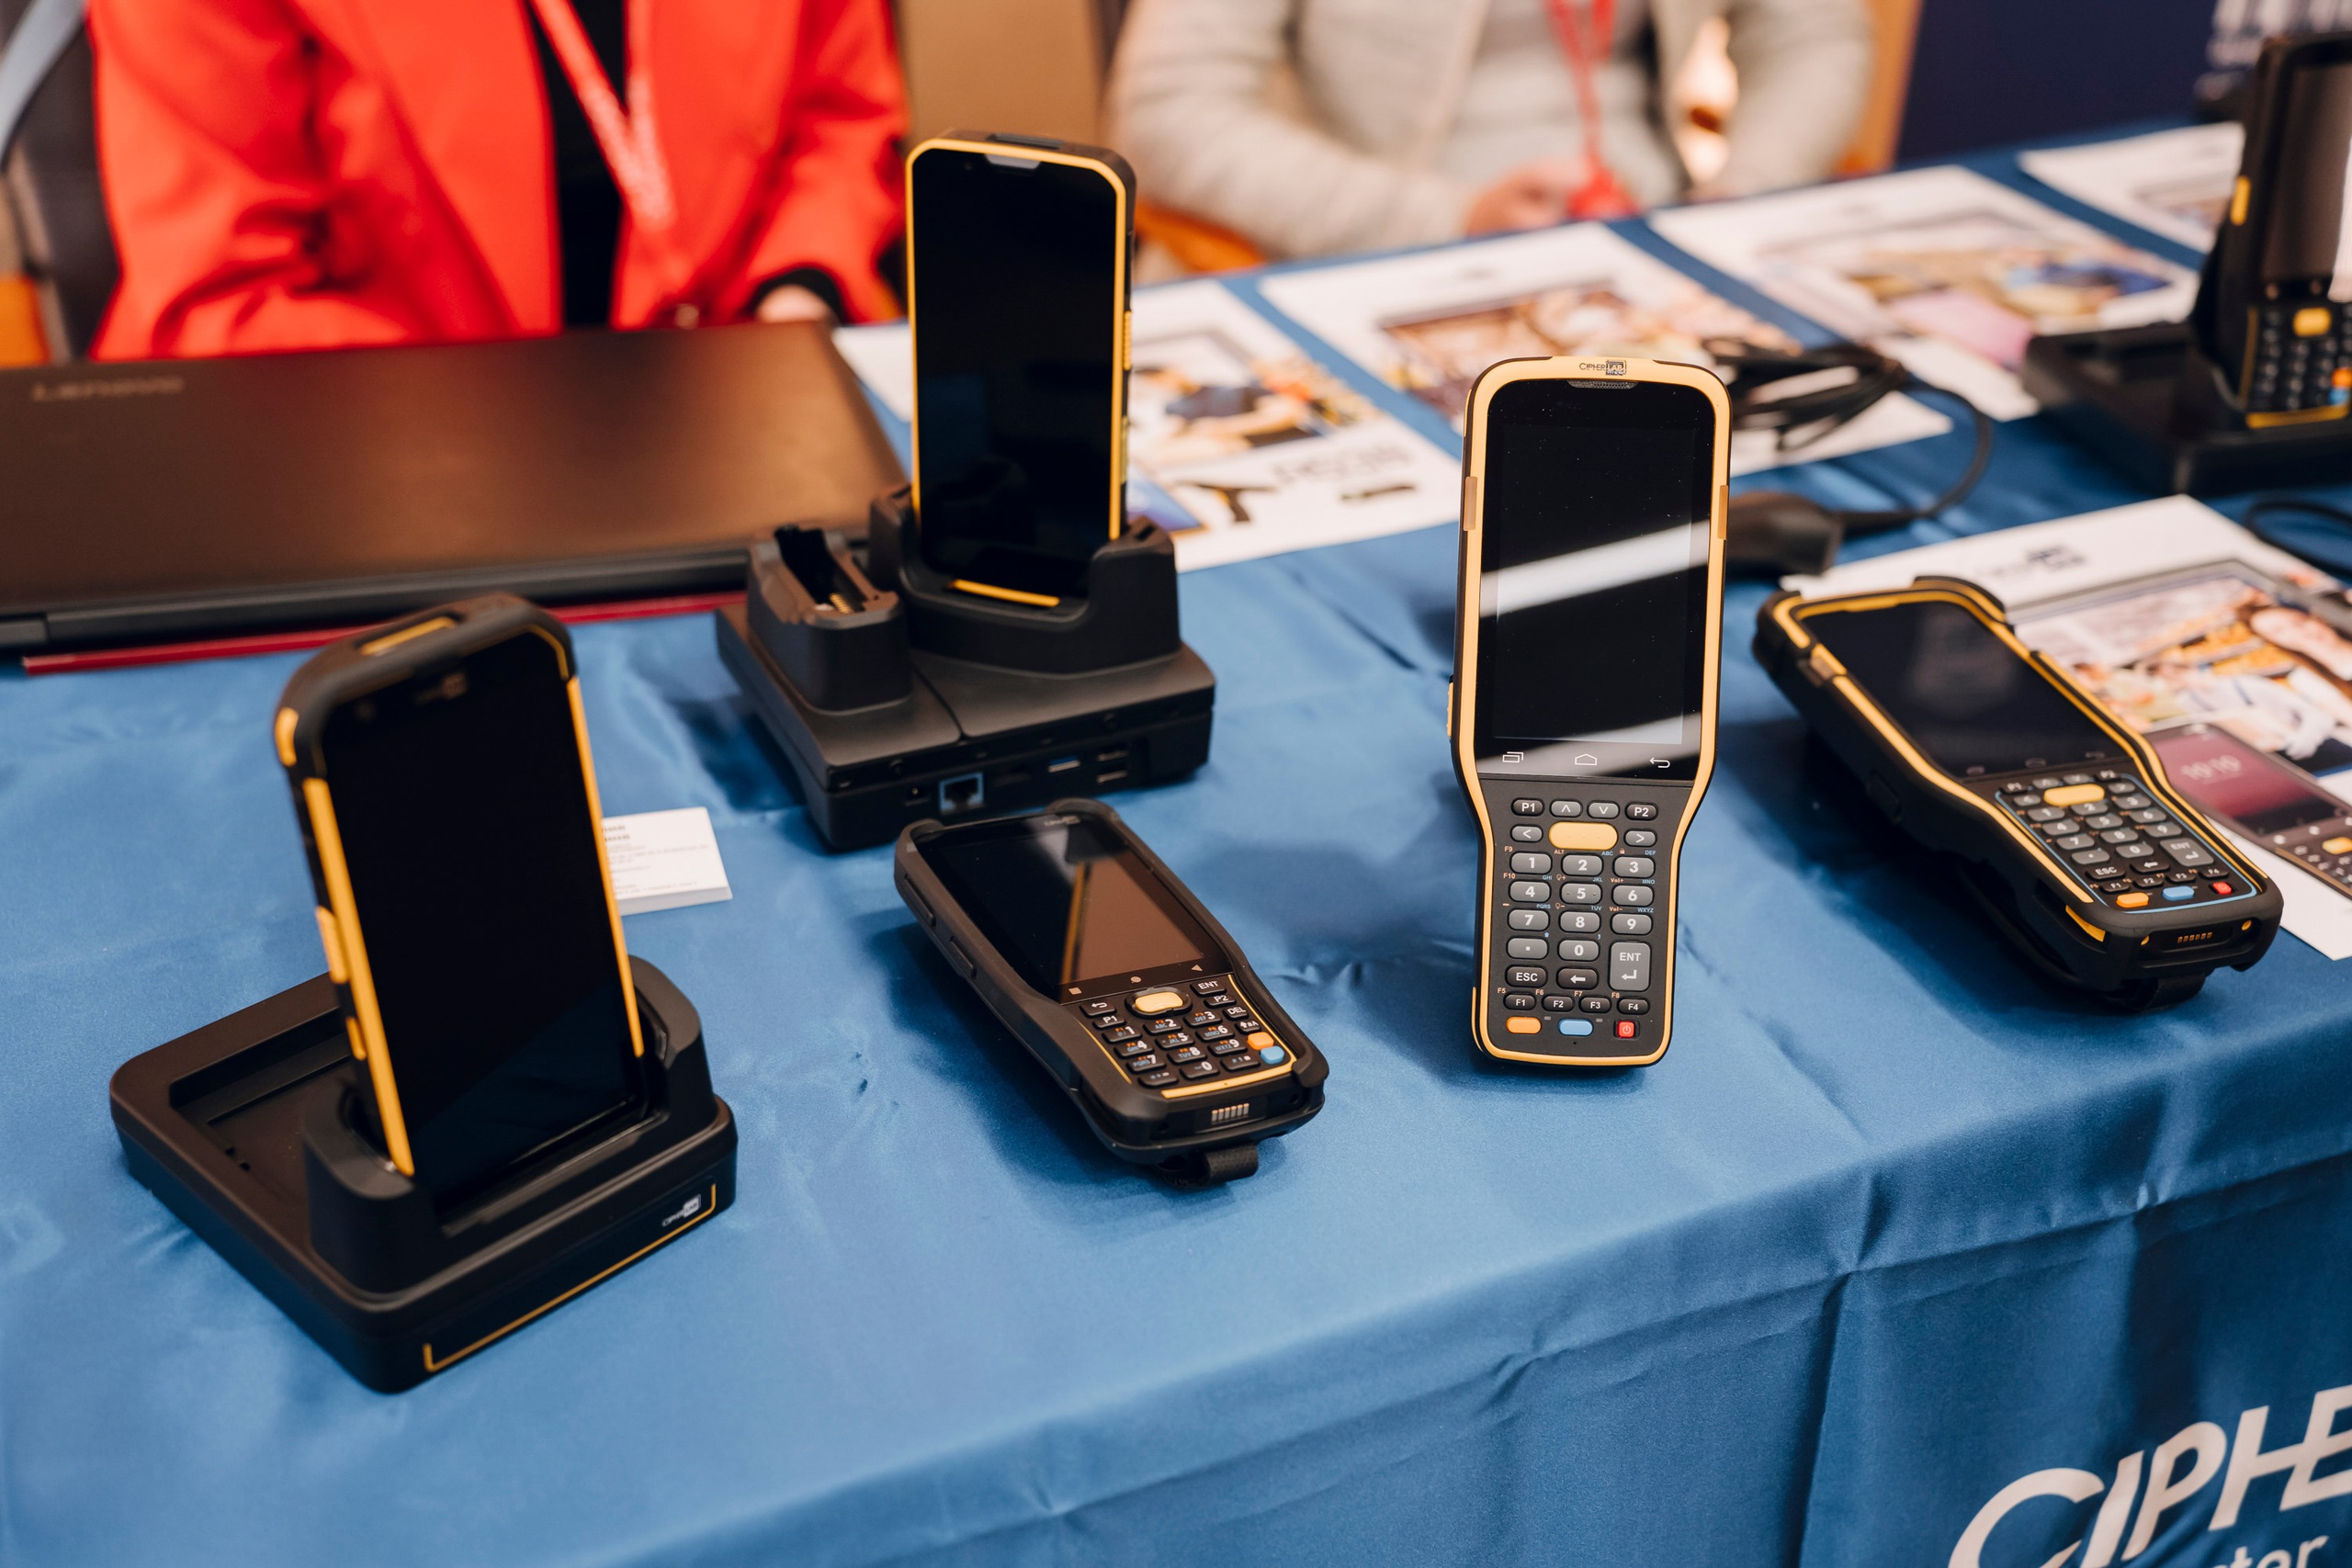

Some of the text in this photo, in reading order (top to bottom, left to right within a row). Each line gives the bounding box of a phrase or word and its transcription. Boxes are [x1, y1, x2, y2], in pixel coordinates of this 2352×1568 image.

[1521, 803, 1535, 813] P1
[1634, 807, 1649, 818] P2
[2170, 841, 2190, 851] ENT
[1529, 857, 1535, 869] 1
[1577, 859, 1588, 871] 2
[1629, 861, 1639, 873] 3
[2095, 866, 2118, 875] ESC
[1525, 886, 1535, 897] 4
[1577, 888, 1586, 899] 5
[1627, 889, 1638, 901] 6
[1524, 914, 1534, 926] 7
[1575, 917, 1585, 928] 8
[1626, 919, 1637, 930] 9
[1574, 944, 1584, 956] 0
[1619, 953, 1641, 962] ENT
[1516, 972, 1538, 982] ESC
[1197, 980, 1219, 990] ENT
[1214, 995, 1229, 1003] P2
[1227, 1006, 1247, 1015] DEL
[1589, 1001, 1600, 1010] F3
[1102, 1015, 1118, 1024] P1
[1204, 1011, 1216, 1020] 3
[1165, 1019, 1177, 1027] 2
[1125, 1026, 1136, 1035] 1
[1217, 1025, 1228, 1034] 6
[1177, 1032, 1188, 1042] 5
[1136, 1041, 1148, 1049] 4
[1228, 1039, 1239, 1048] 9
[1189, 1046, 1201, 1055] 8
[1147, 1054, 1156, 1064] 7
[1201, 1061, 1213, 1071] 0
